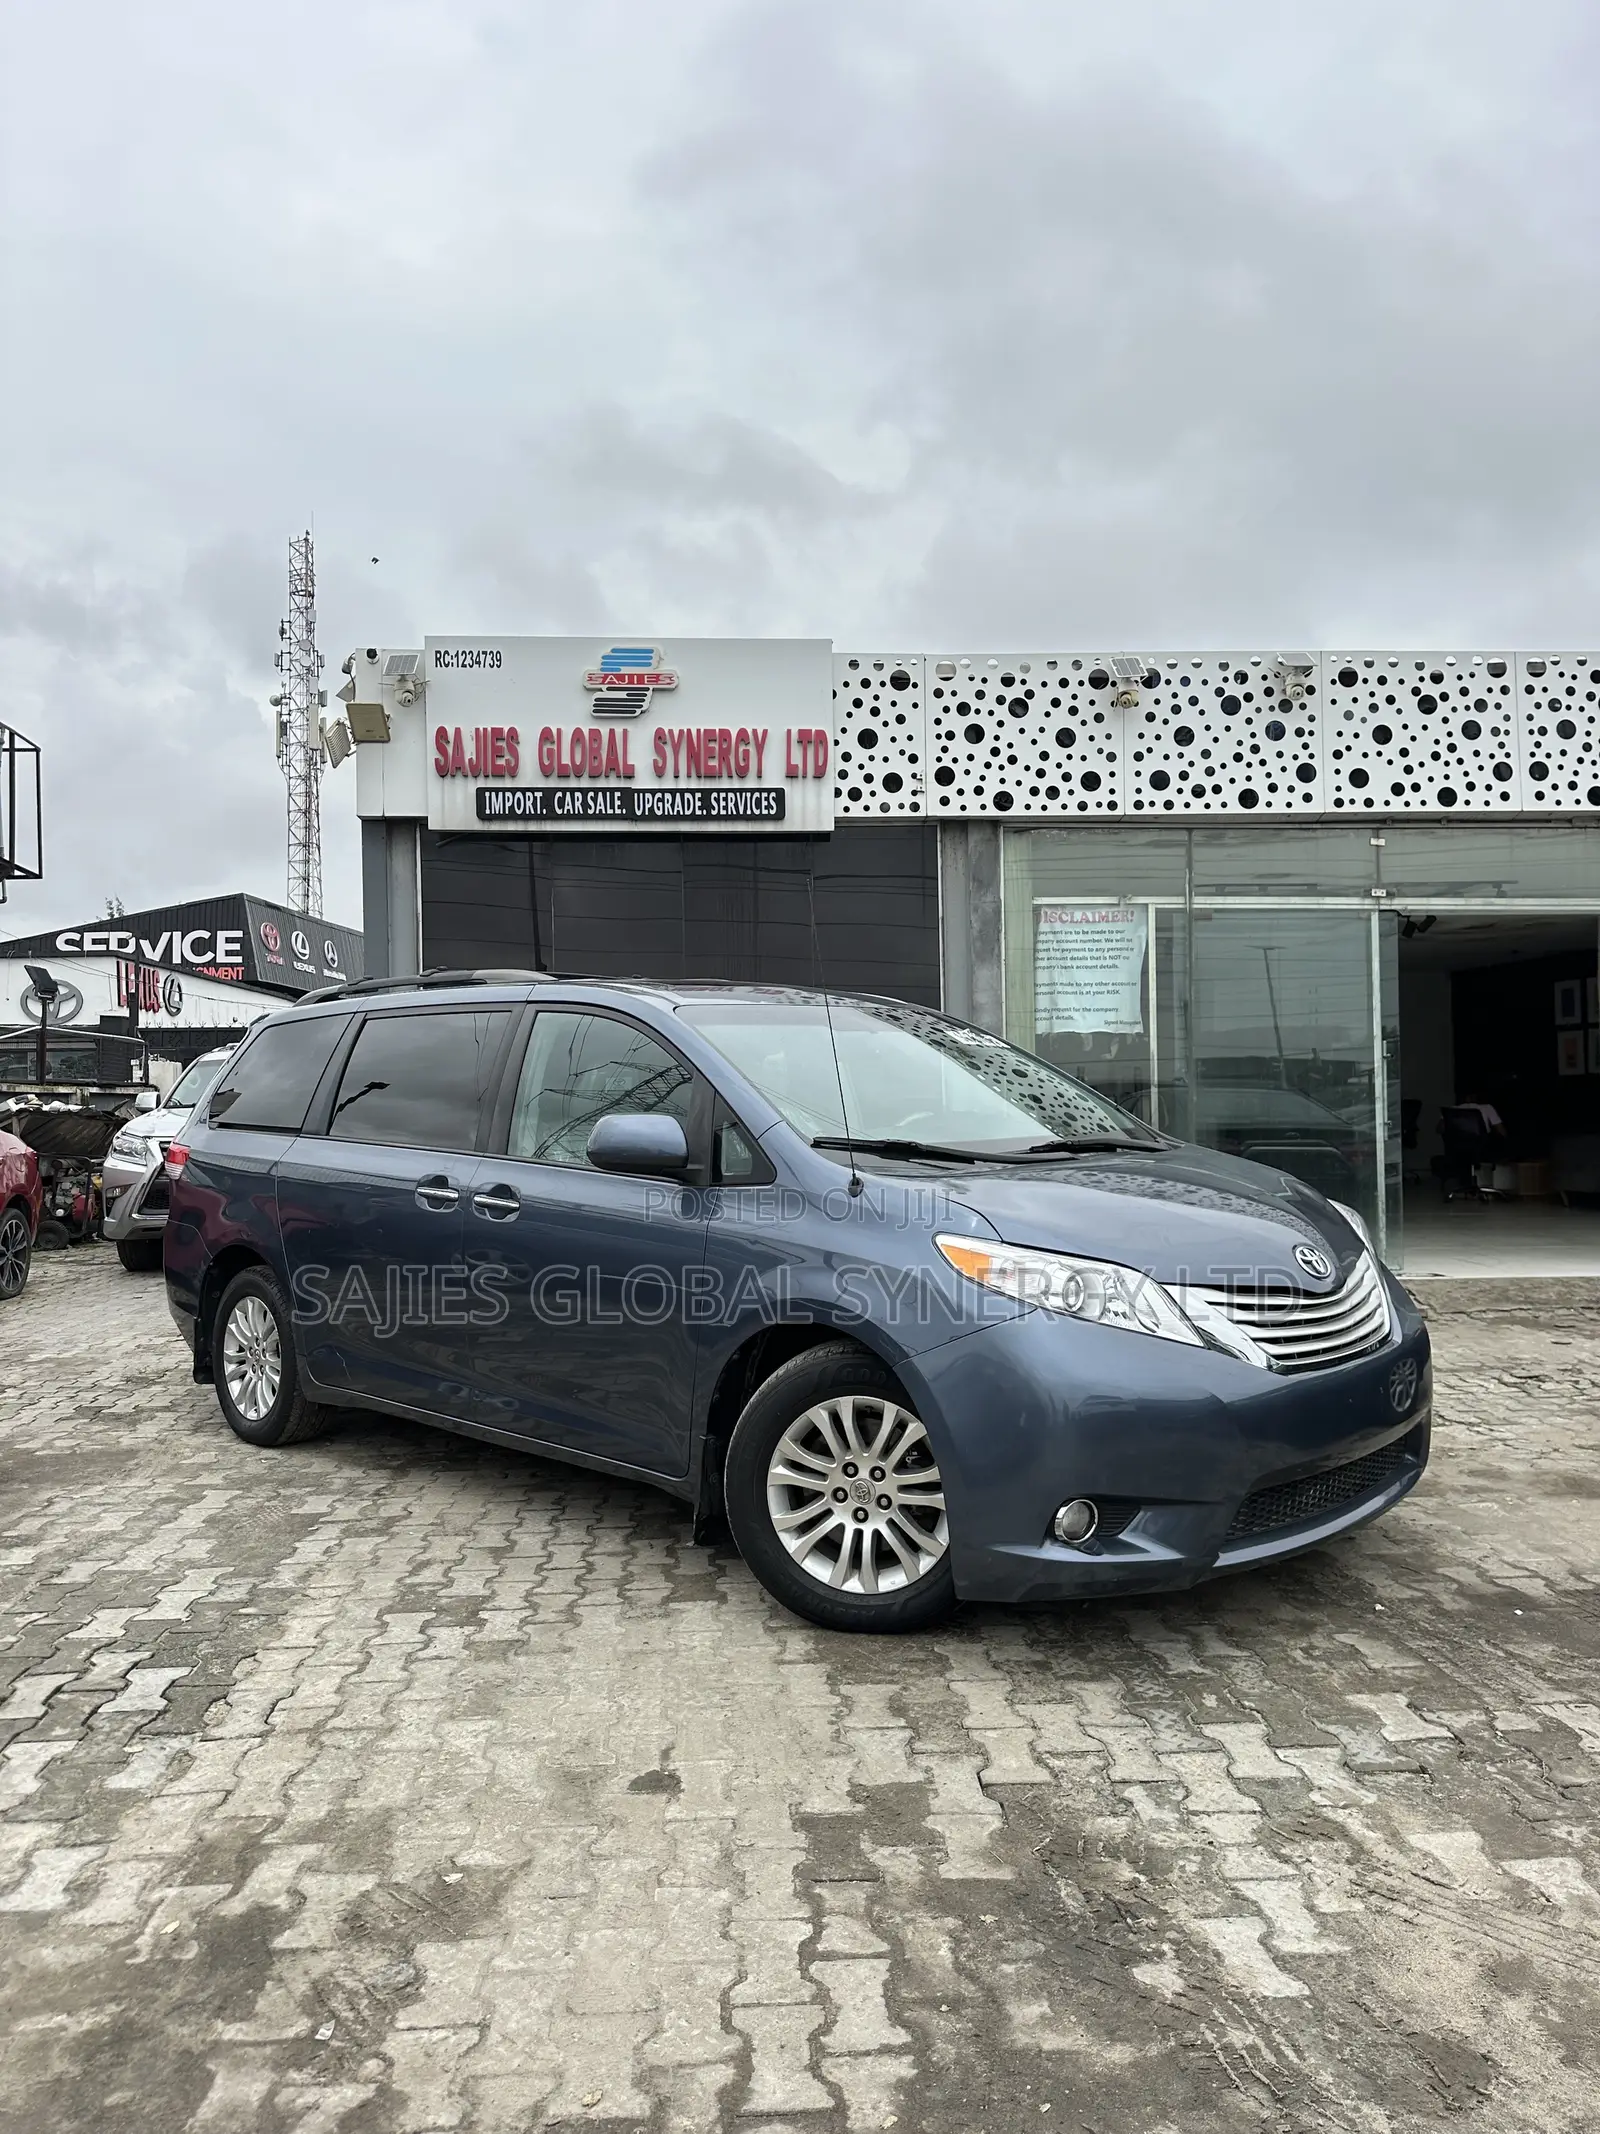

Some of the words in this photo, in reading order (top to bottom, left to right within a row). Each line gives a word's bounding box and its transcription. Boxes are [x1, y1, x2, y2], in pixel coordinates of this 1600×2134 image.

[434, 649, 502, 669] RC:1234739
[586, 673, 677, 685] SAJIES
[434, 725, 520, 778] SAJIES
[538, 726, 636, 778] GLOBAL
[652, 726, 768, 778] SYNERGY
[785, 728, 830, 779] LTD
[485, 791, 547, 815] IMPORT.
[554, 791, 584, 815] CAR
[587, 791, 627, 815] SALE.
[634, 791, 707, 816] UPGRADE.
[710, 791, 777, 816] SERVICES
